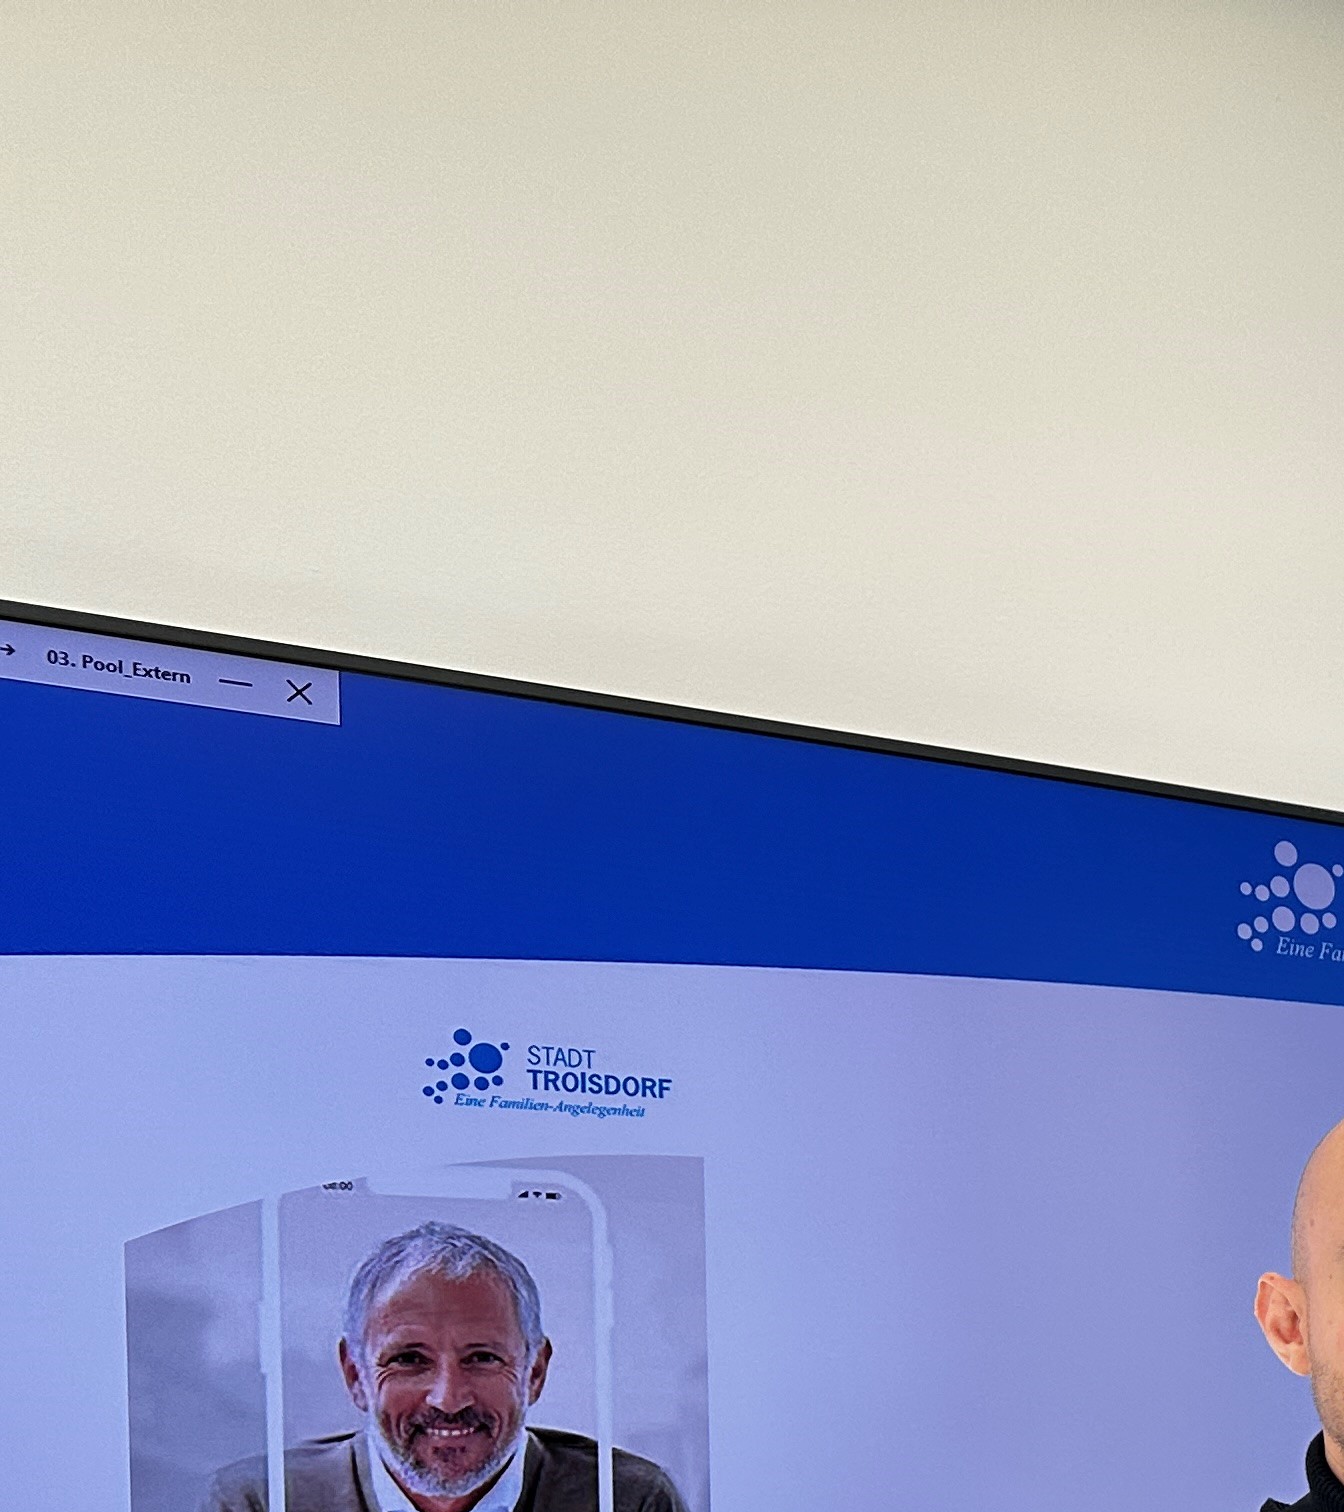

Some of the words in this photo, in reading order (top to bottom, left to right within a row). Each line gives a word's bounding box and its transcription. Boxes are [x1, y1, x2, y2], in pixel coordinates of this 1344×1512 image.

[46, 648, 77, 668] 03.
[81, 653, 192, 685] Pool_Extern
[1275, 936, 1315, 960] Eine
[526, 1044, 597, 1070] STADT
[525, 1068, 673, 1100] TROISDORF
[453, 1092, 487, 1109] Eine
[488, 1095, 646, 1119] Familien-Angelegenheit
